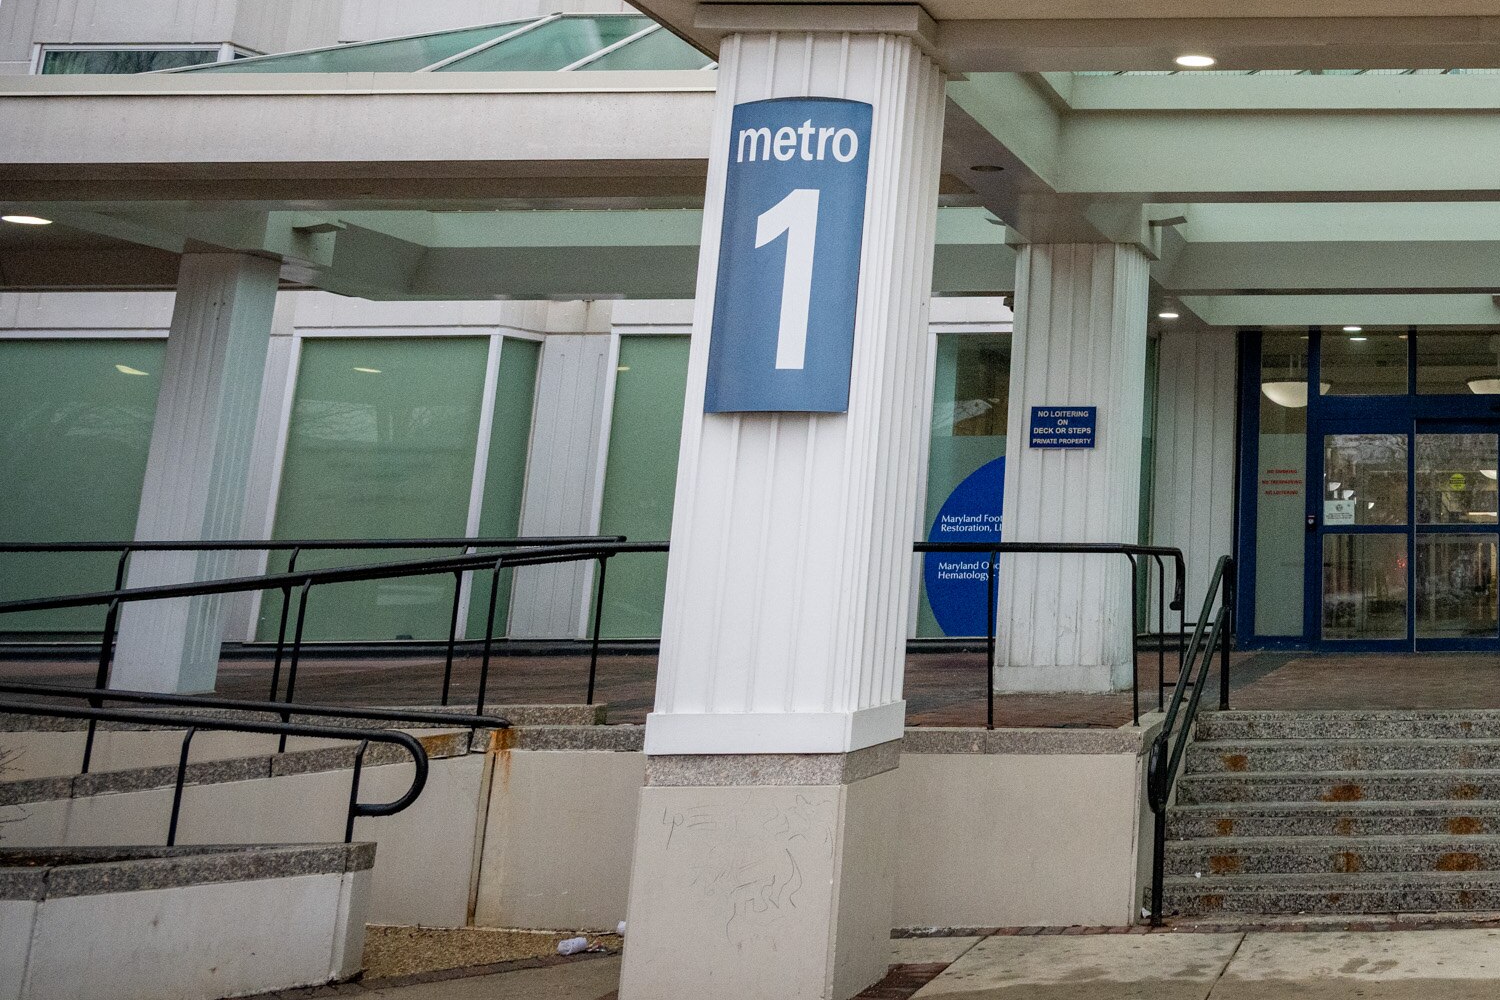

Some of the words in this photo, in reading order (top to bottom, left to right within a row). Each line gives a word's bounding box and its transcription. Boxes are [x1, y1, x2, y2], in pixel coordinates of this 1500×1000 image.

[737, 118, 859, 163] metro
[754, 188, 820, 370] 1
[941, 514, 982, 525] Maryland
[940, 524, 992, 532] Restoration,
[938, 561, 979, 572] Maryland
[938, 570, 990, 582] Hematology
